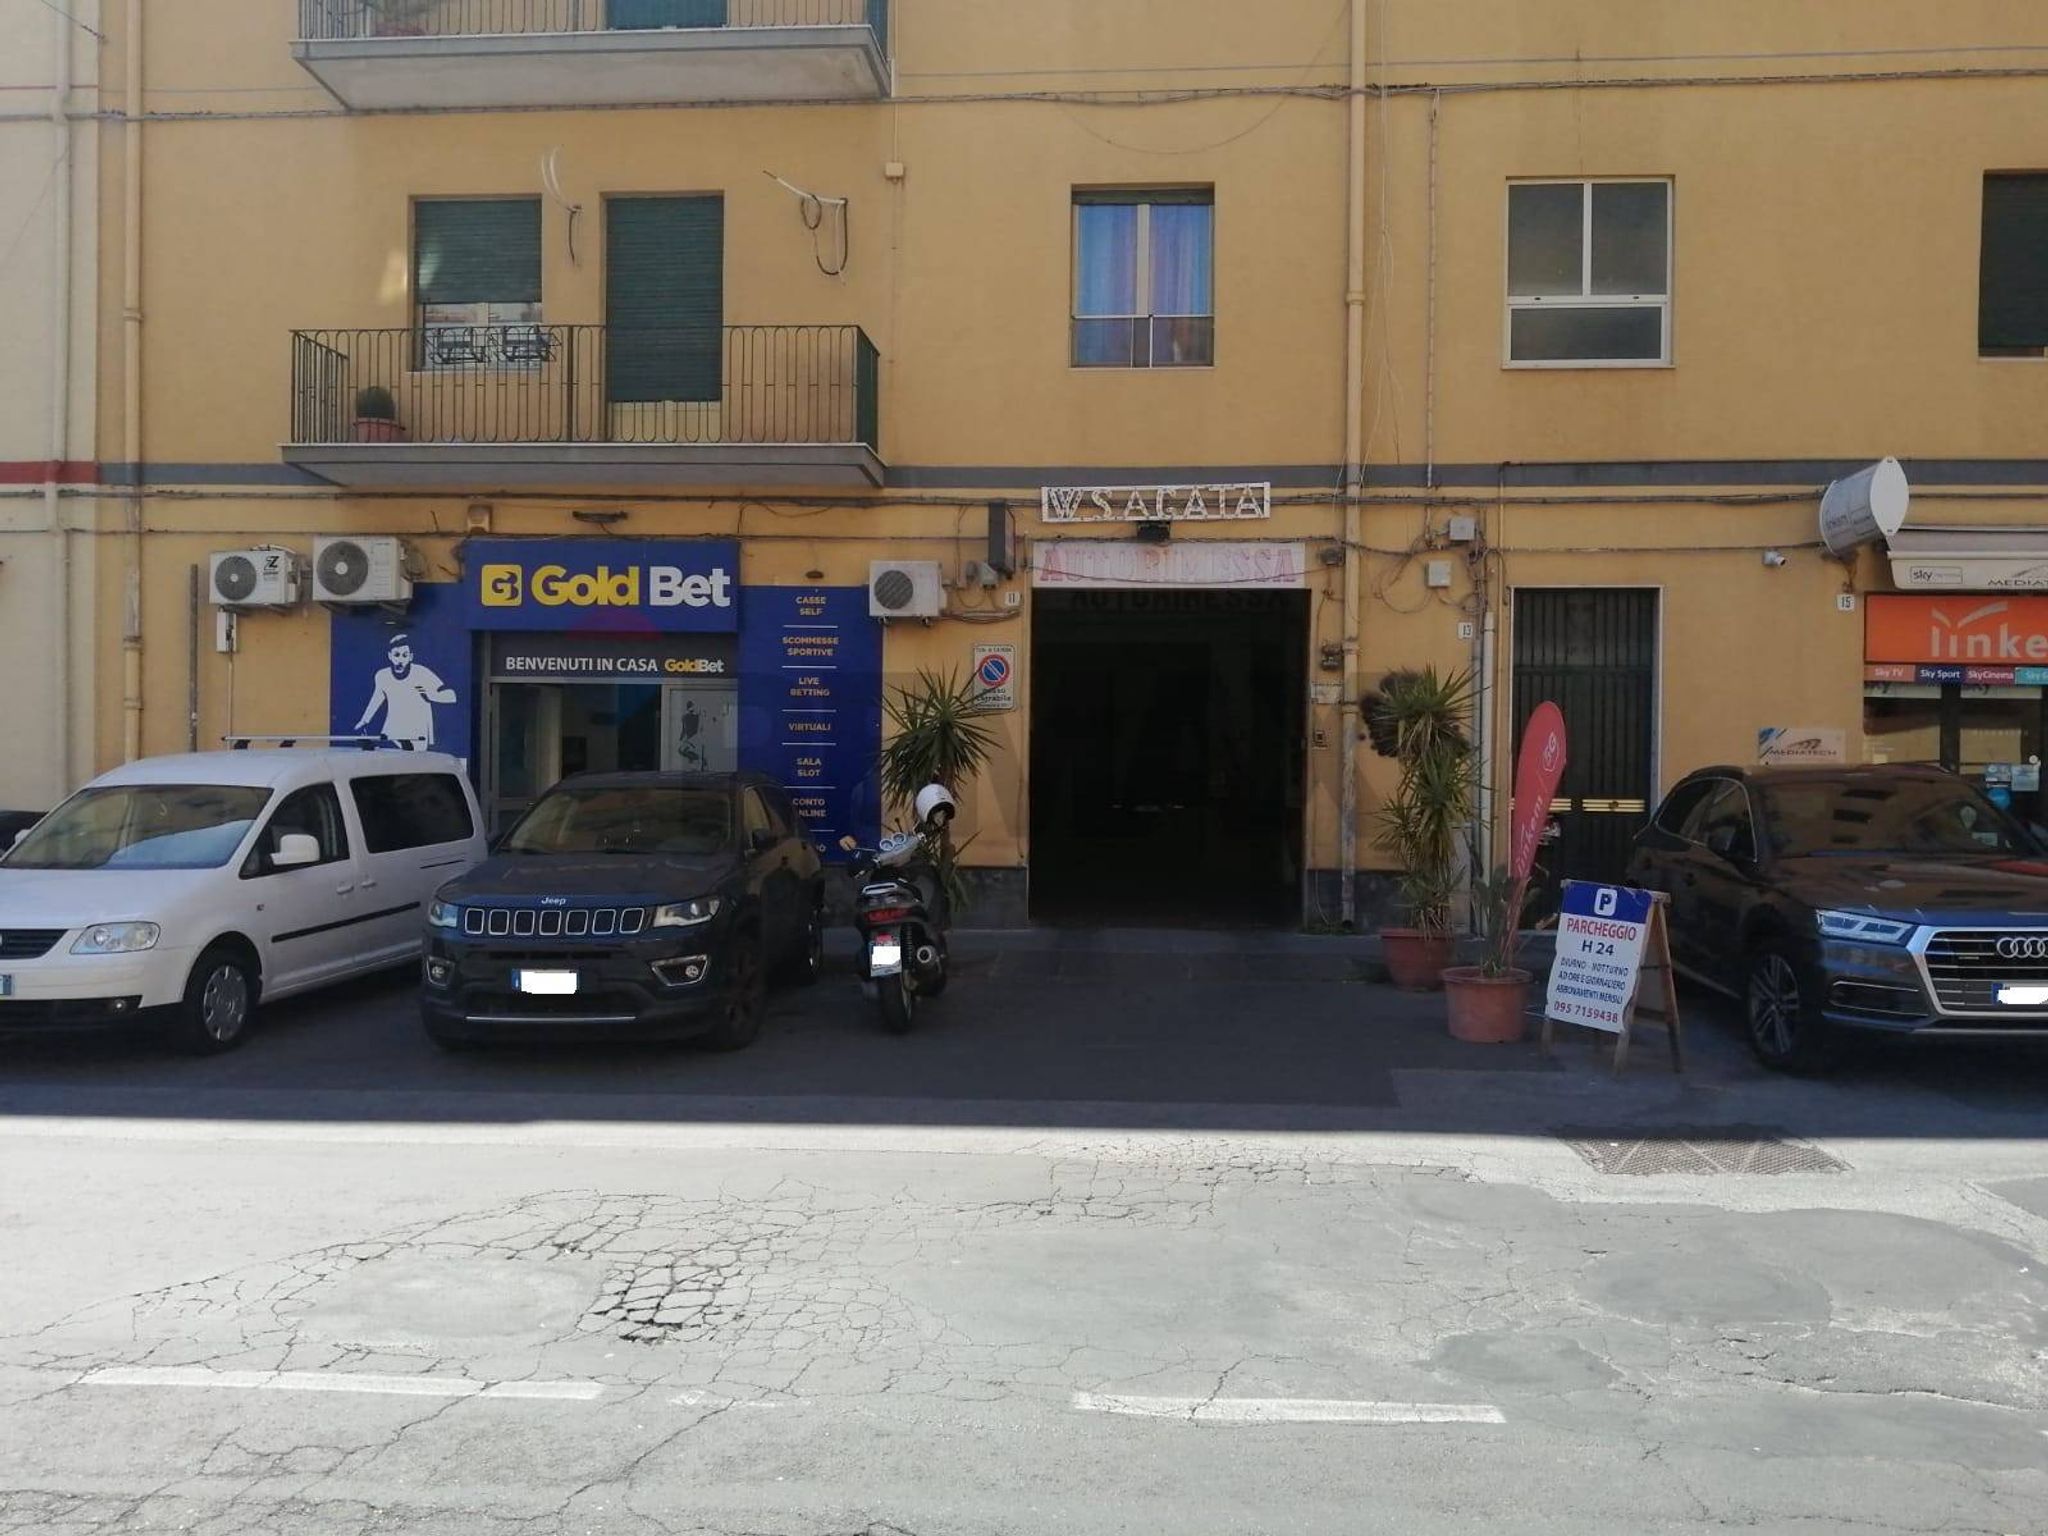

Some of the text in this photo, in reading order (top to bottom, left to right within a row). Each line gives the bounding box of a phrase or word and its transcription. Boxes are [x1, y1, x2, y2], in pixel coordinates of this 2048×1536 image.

[530, 564, 640, 607] Gold
[649, 566, 731, 608] Bet
[795, 596, 827, 605] CASSE
[1840, 596, 1851, 608] 15
[799, 607, 823, 616] SELF
[782, 636, 839, 645] SCOMMESSE
[786, 648, 834, 657] SPORTIVE
[505, 656, 593, 672] BENVENUTI
[597, 657, 613, 672] IN
[616, 657, 658, 672] CASA
[1892, 667, 1904, 677] TV
[1920, 668, 1960, 680] Sky Sport
[798, 676, 819, 685] LIVE
[789, 688, 830, 697] BETTING
[788, 723, 831, 731] VIRTUALI
[796, 757, 822, 766] SALA
[797, 769, 821, 777] SLOT
[792, 797, 825, 807] CONTO
[541, 896, 567, 906] Jeep
[1599, 893, 1613, 911] P
[1566, 917, 1637, 941] PARCHEGGIO
[1582, 940, 1615, 956] H 24
[1592, 962, 1629, 977] NOTTURNO
[1553, 1001, 1618, 1023] 095 7159438
